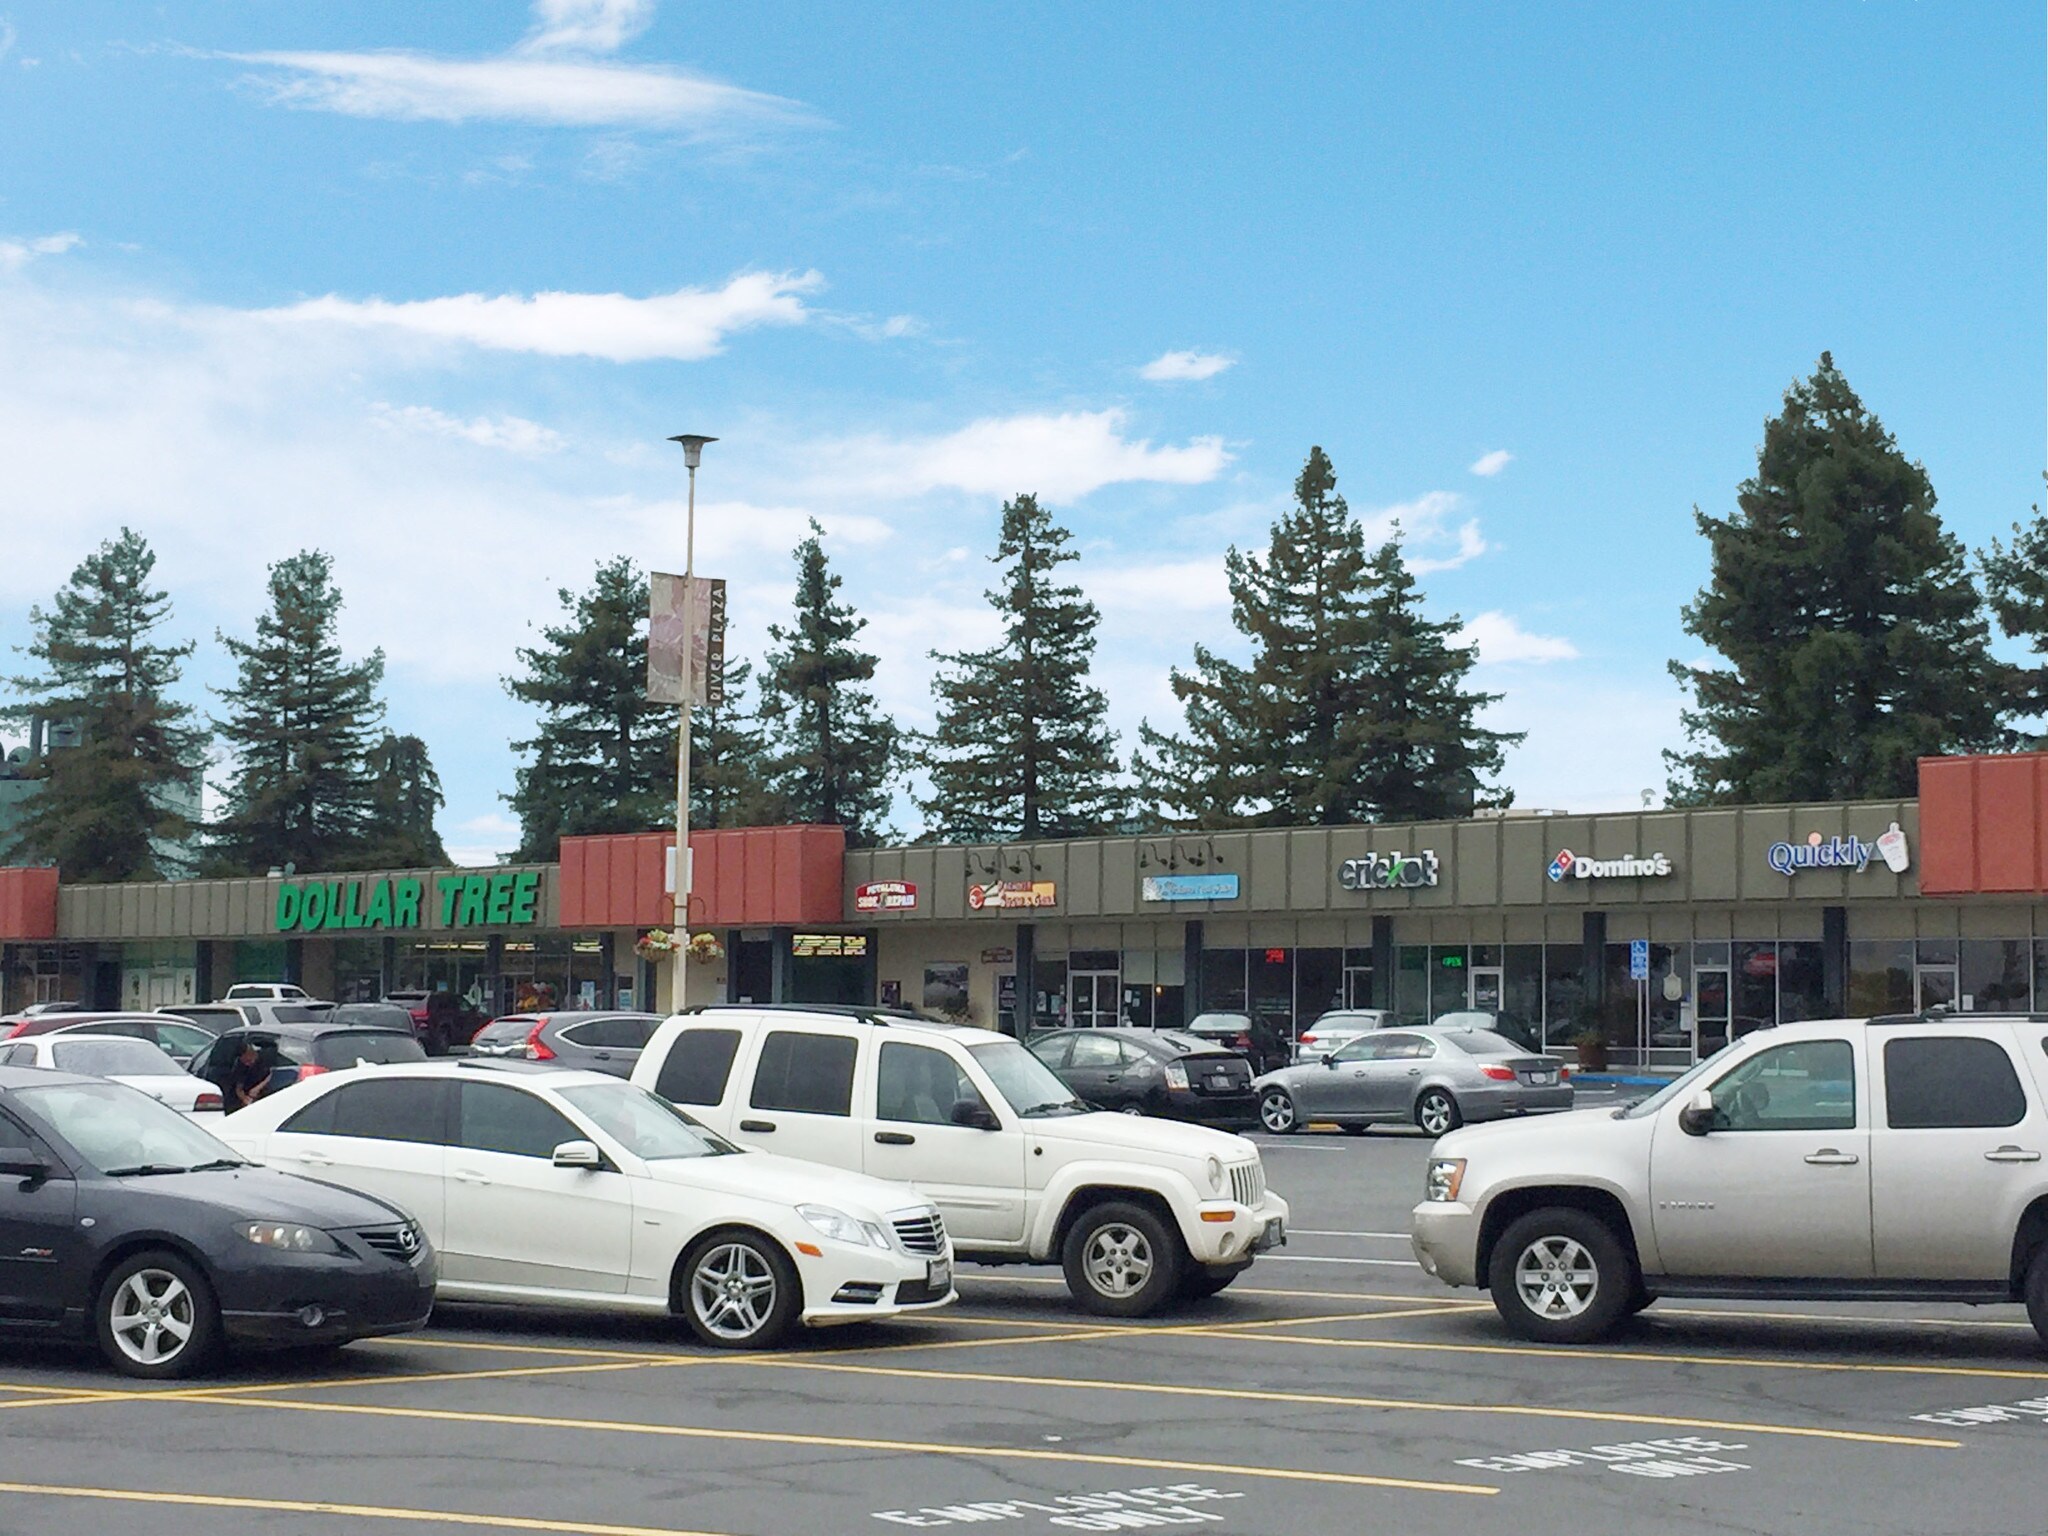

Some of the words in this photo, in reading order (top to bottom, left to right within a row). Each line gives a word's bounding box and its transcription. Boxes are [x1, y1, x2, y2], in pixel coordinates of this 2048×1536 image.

[712, 588, 724, 642] PLAZA
[711, 653, 722, 700] RIVER
[1338, 849, 1439, 889] cricket
[1575, 852, 1672, 878] Domino's
[1768, 832, 1873, 876] Quickly
[276, 878, 422, 931] DOLLAR
[437, 872, 539, 926] TREE
[1454, 1436, 1748, 1472] EMPLOYEE
[1608, 1456, 1751, 1478] ONLY
[870, 1483, 1246, 1526] EMPLOYEE
[1050, 1506, 1224, 1531] ONLY
